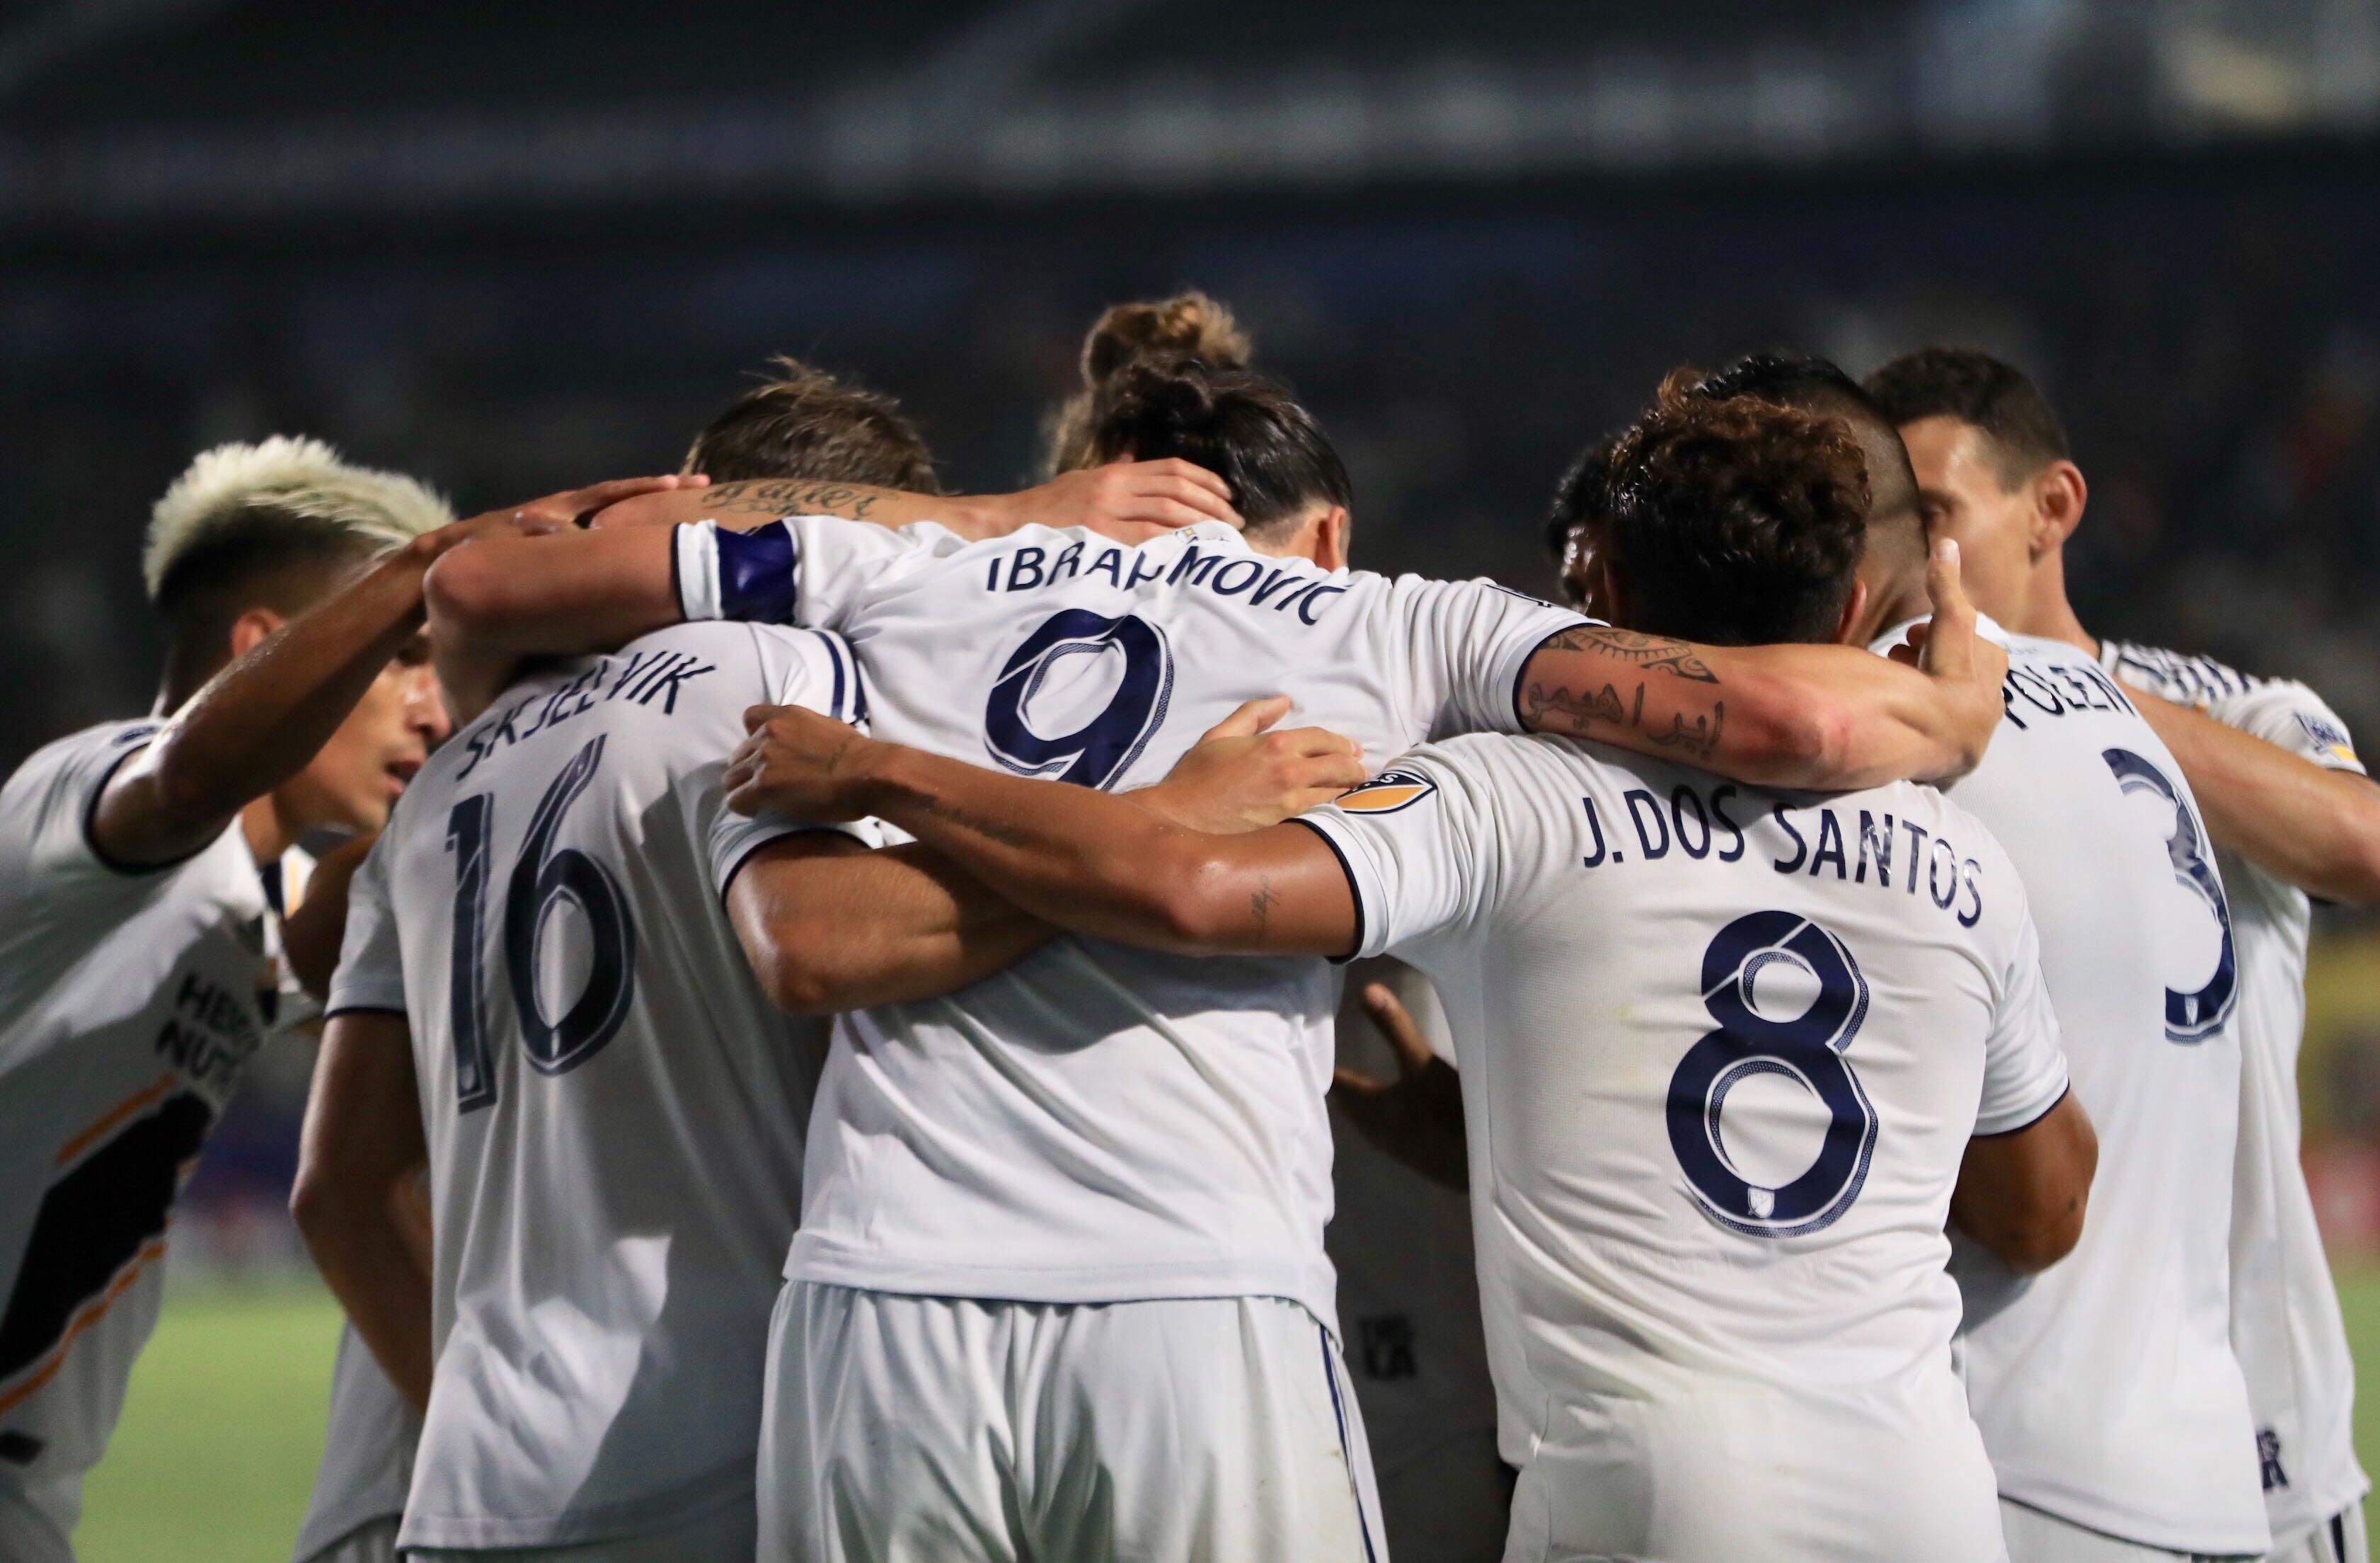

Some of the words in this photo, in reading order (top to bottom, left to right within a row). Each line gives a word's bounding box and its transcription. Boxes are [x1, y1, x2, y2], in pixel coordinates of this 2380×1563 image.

[984, 609, 1175, 792] 9
[986, 541, 1350, 626] IBRAHMOVIC
[445, 732, 636, 1114] 16
[1773, 802, 1982, 928] SANTOS
[2101, 748, 2239, 1045] 3
[1667, 910, 1878, 1239] 8
